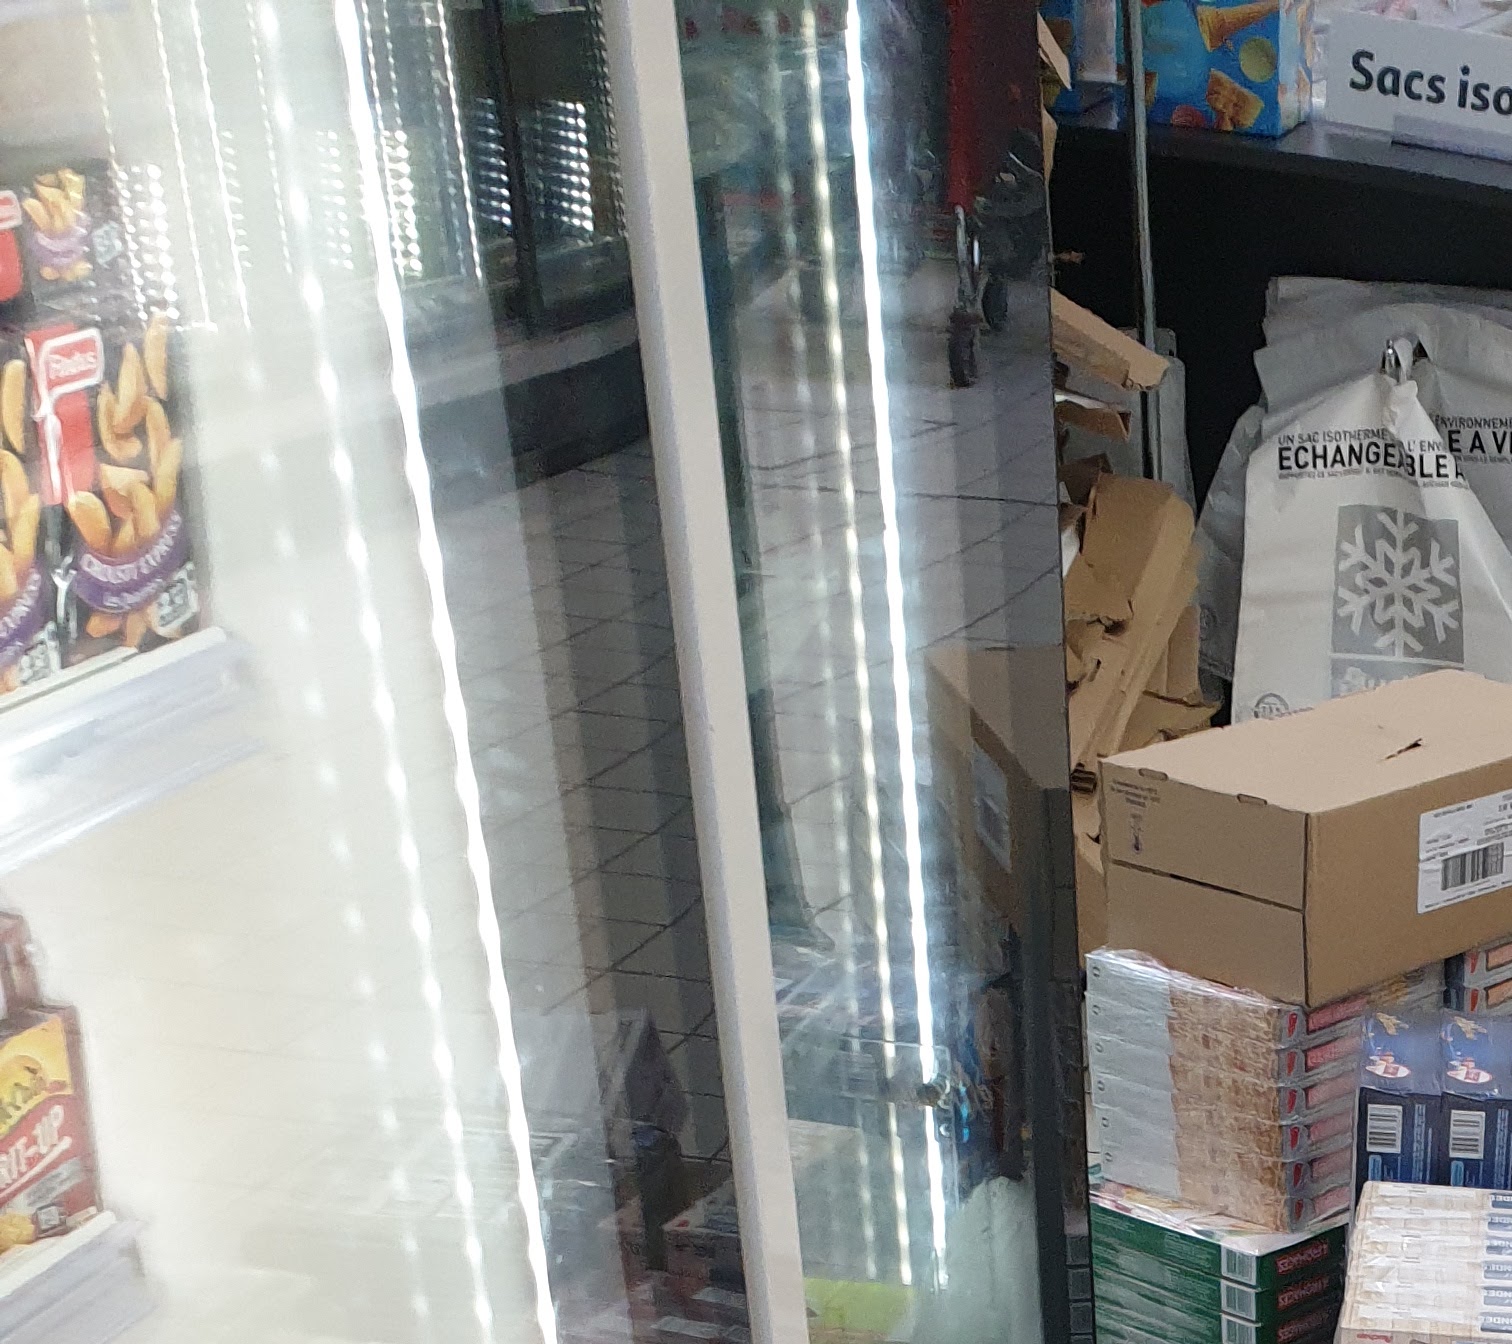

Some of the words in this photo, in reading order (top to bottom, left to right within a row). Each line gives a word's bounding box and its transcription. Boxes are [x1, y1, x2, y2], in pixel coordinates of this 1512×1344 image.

[1349, 49, 1446, 104] Sacs
[1298, 431, 1319, 444] SAC
[1469, 431, 1486, 454] A
